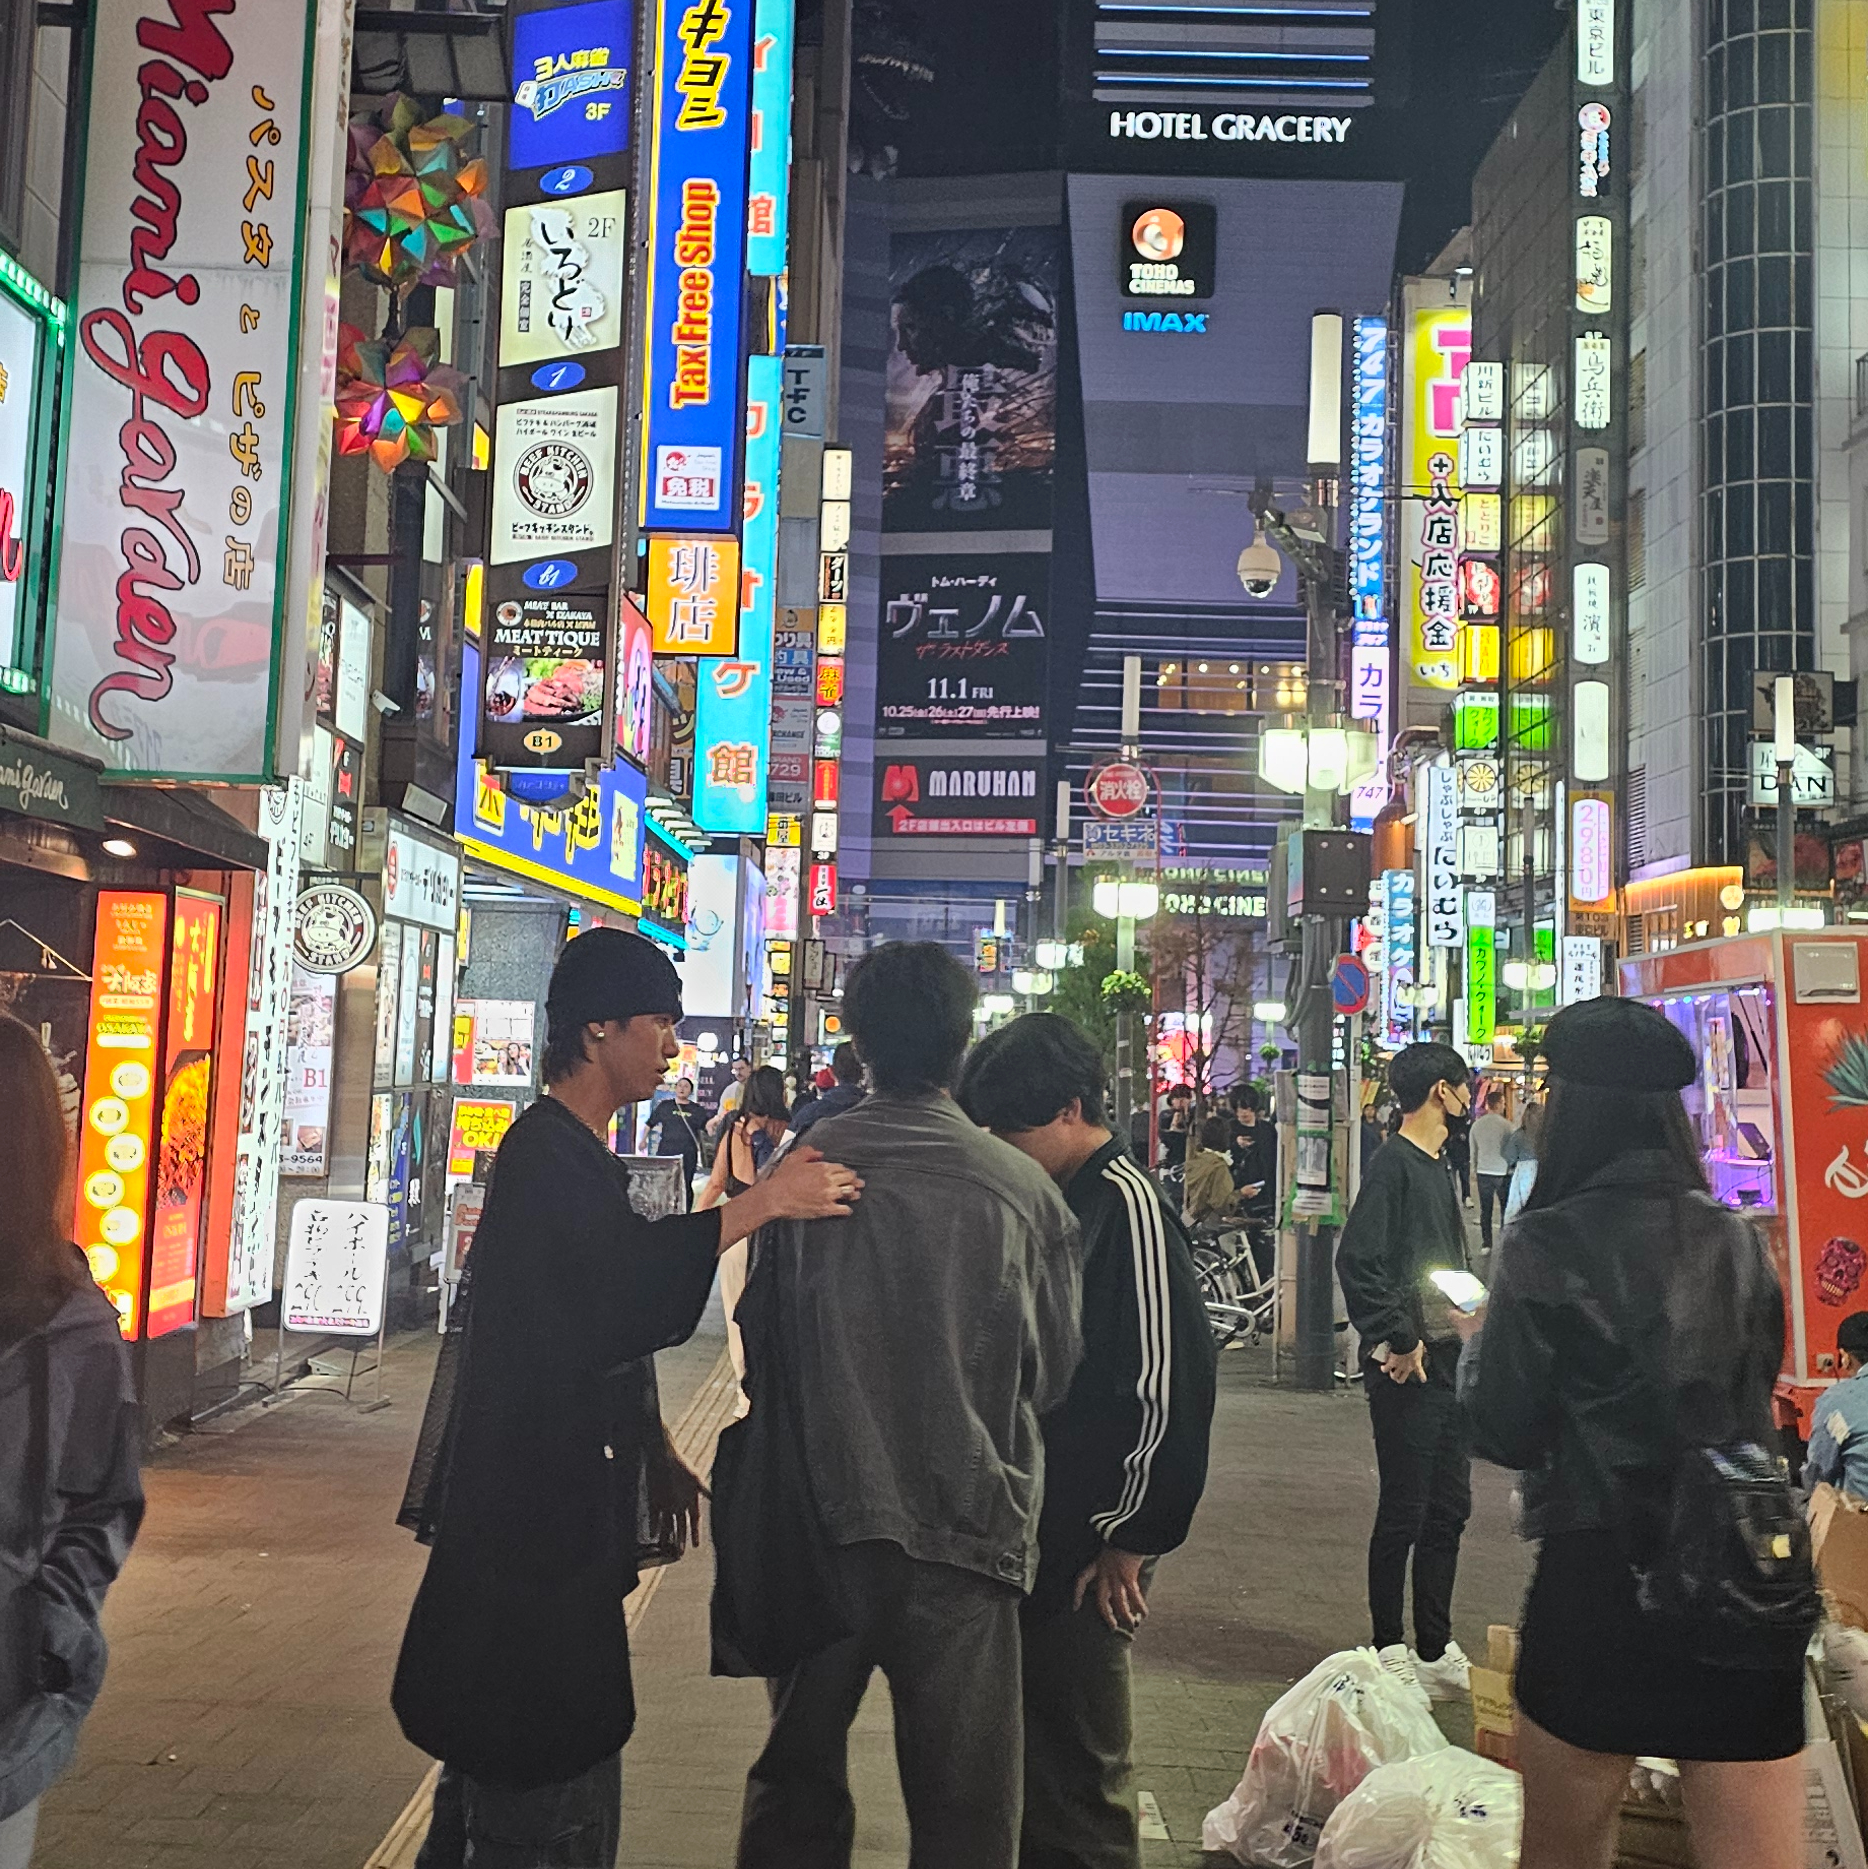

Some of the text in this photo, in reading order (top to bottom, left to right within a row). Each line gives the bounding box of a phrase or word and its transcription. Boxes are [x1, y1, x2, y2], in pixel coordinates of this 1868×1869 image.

[585, 102, 612, 121] 3F
[1110, 112, 1352, 143] HOTEL GRACERY
[555, 169, 577, 191] 2
[588, 217, 616, 239] 2F
[540, 221, 583, 343] いろどり
[1129, 263, 1179, 280] TOHO
[673, 181, 718, 408] Tax Free Shop
[1128, 280, 1195, 295] CINEMAS
[1123, 311, 1207, 333] IMAX
[1360, 327, 1387, 404] 747
[519, 446, 588, 479] BEEF KITCHEN
[667, 477, 711, 497] 免税
[524, 600, 569, 611] MEAT BAR
[885, 593, 1046, 638] ヴェノム
[512, 644, 584, 658] ミートティーク
[927, 677, 994, 699] 11.1 FRI
[929, 770, 1036, 797] MARUHAN
[1099, 780, 1143, 801] 消火栓
[1356, 786, 1384, 799] 747
[1440, 771, 1454, 843] しゃぶしゃぶ
[1102, 825, 1155, 842] セキネ
[1579, 804, 1595, 898] 2980円
[1433, 845, 1458, 940] にいむら
[316, 892, 363, 926] KITCHEN
[1390, 872, 1415, 967] カラオケ
[303, 1068, 328, 1088] B1
[343, 1212, 368, 1281] ハイボール
